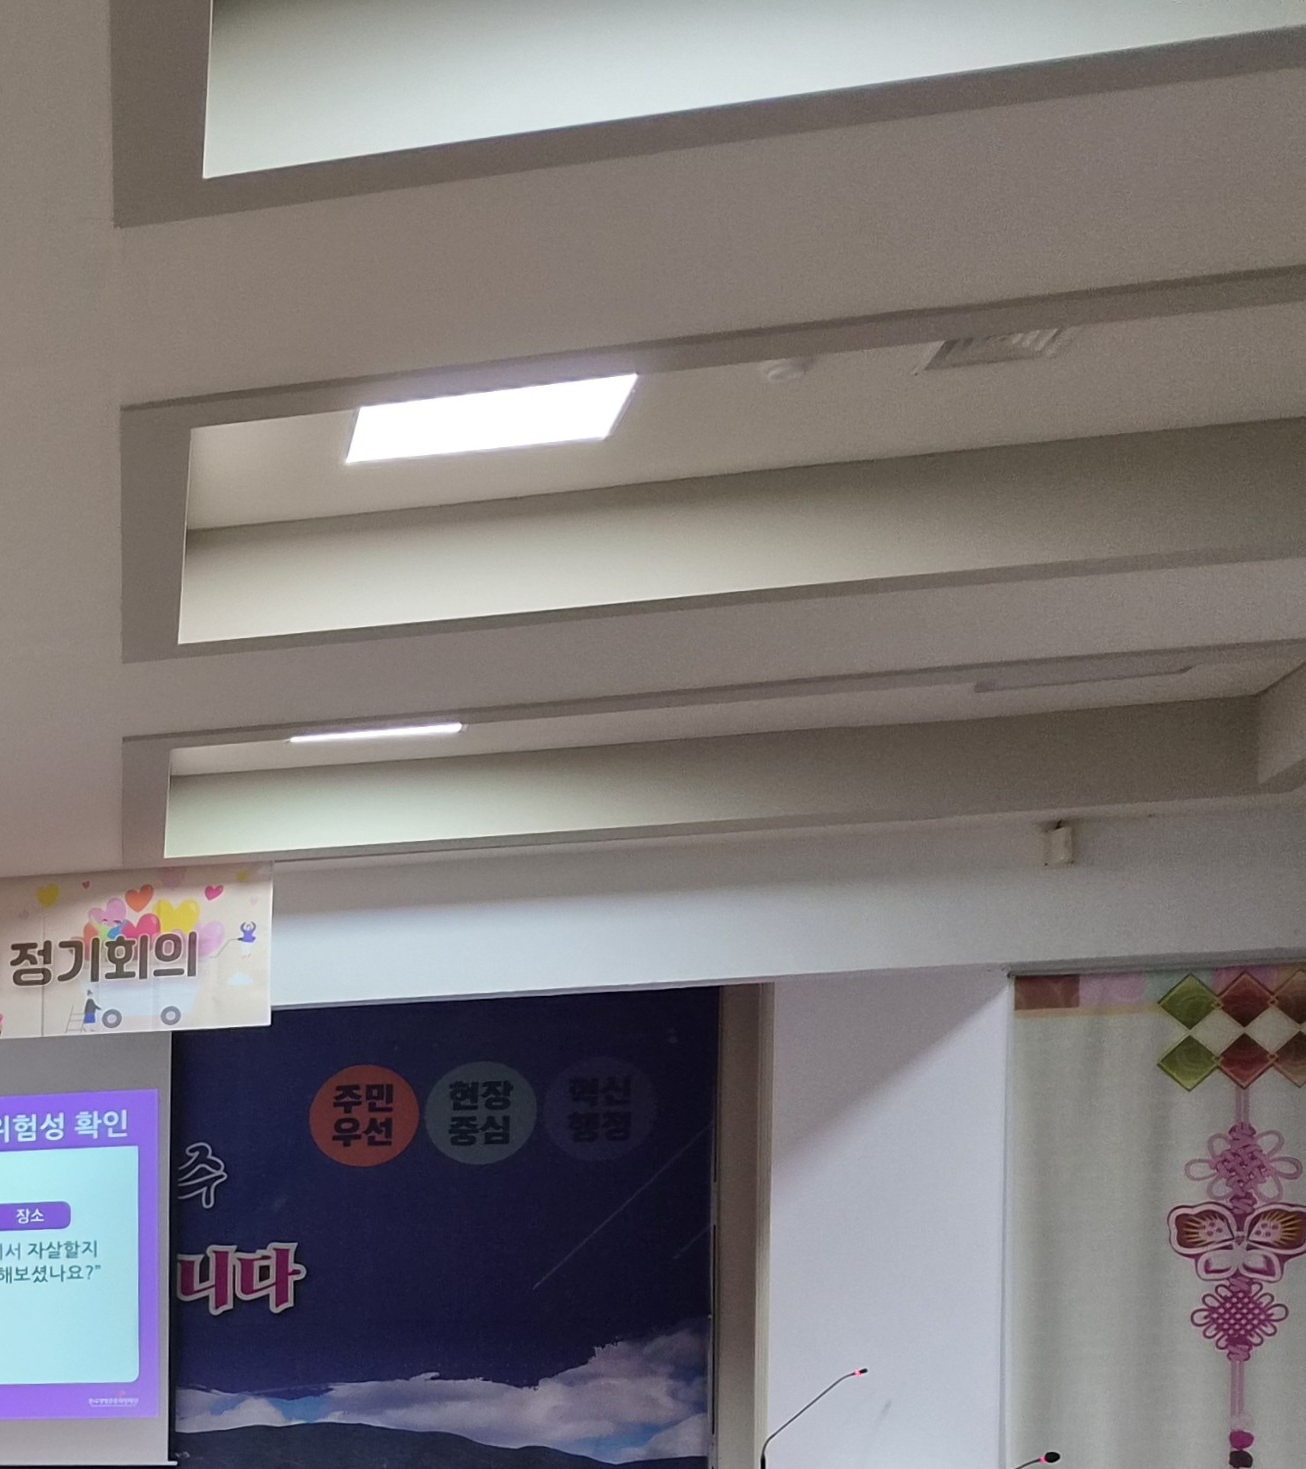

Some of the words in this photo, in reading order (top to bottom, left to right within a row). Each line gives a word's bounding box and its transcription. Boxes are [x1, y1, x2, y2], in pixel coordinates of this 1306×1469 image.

[9, 932, 197, 987] 정기회의
[332, 1083, 394, 1114] 주민
[448, 1080, 513, 1112] 현장
[75, 1109, 128, 1139] 확인
[331, 1116, 394, 1148] 우선
[448, 1116, 512, 1148] 중심
[16, 1208, 44, 1224] 장소
[28, 1240, 98, 1259] 자살할지
[177, 1242, 307, 1315] 니다
